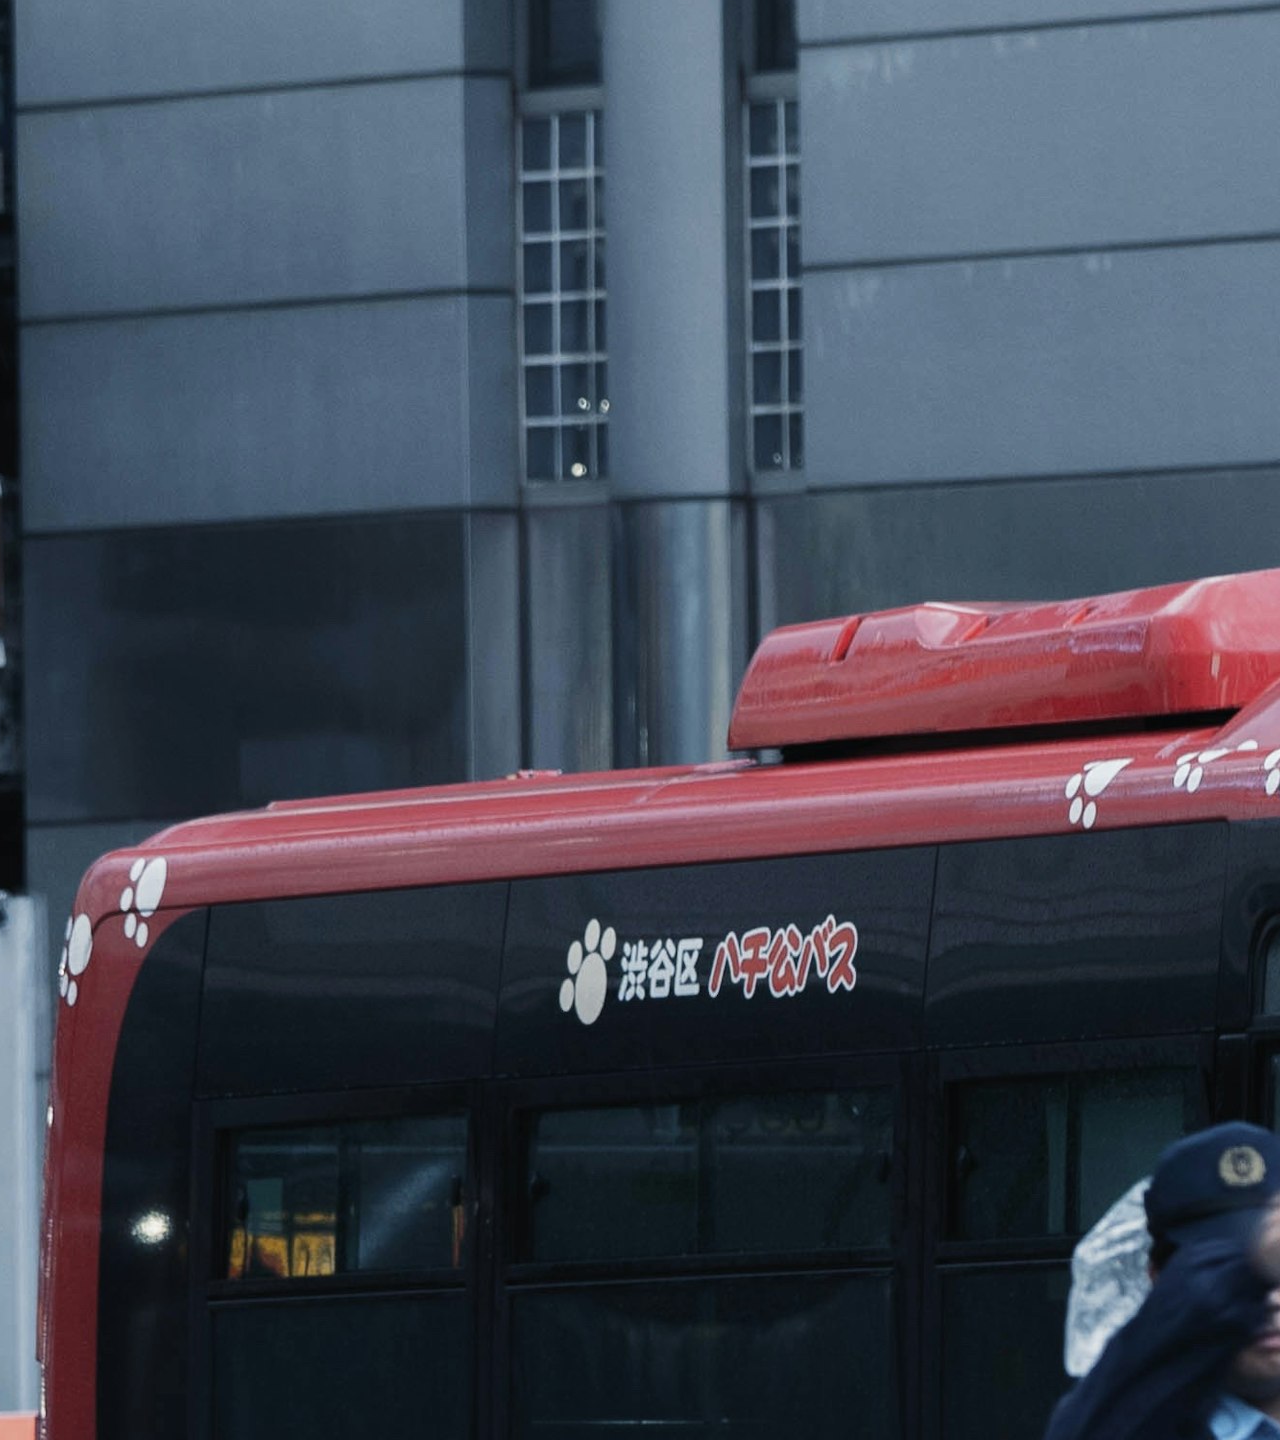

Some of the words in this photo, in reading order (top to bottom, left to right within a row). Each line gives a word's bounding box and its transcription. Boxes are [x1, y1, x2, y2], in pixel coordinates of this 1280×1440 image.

[618, 937, 704, 1001] 渋谷区
[708, 913, 859, 1000] ハチ公バス
